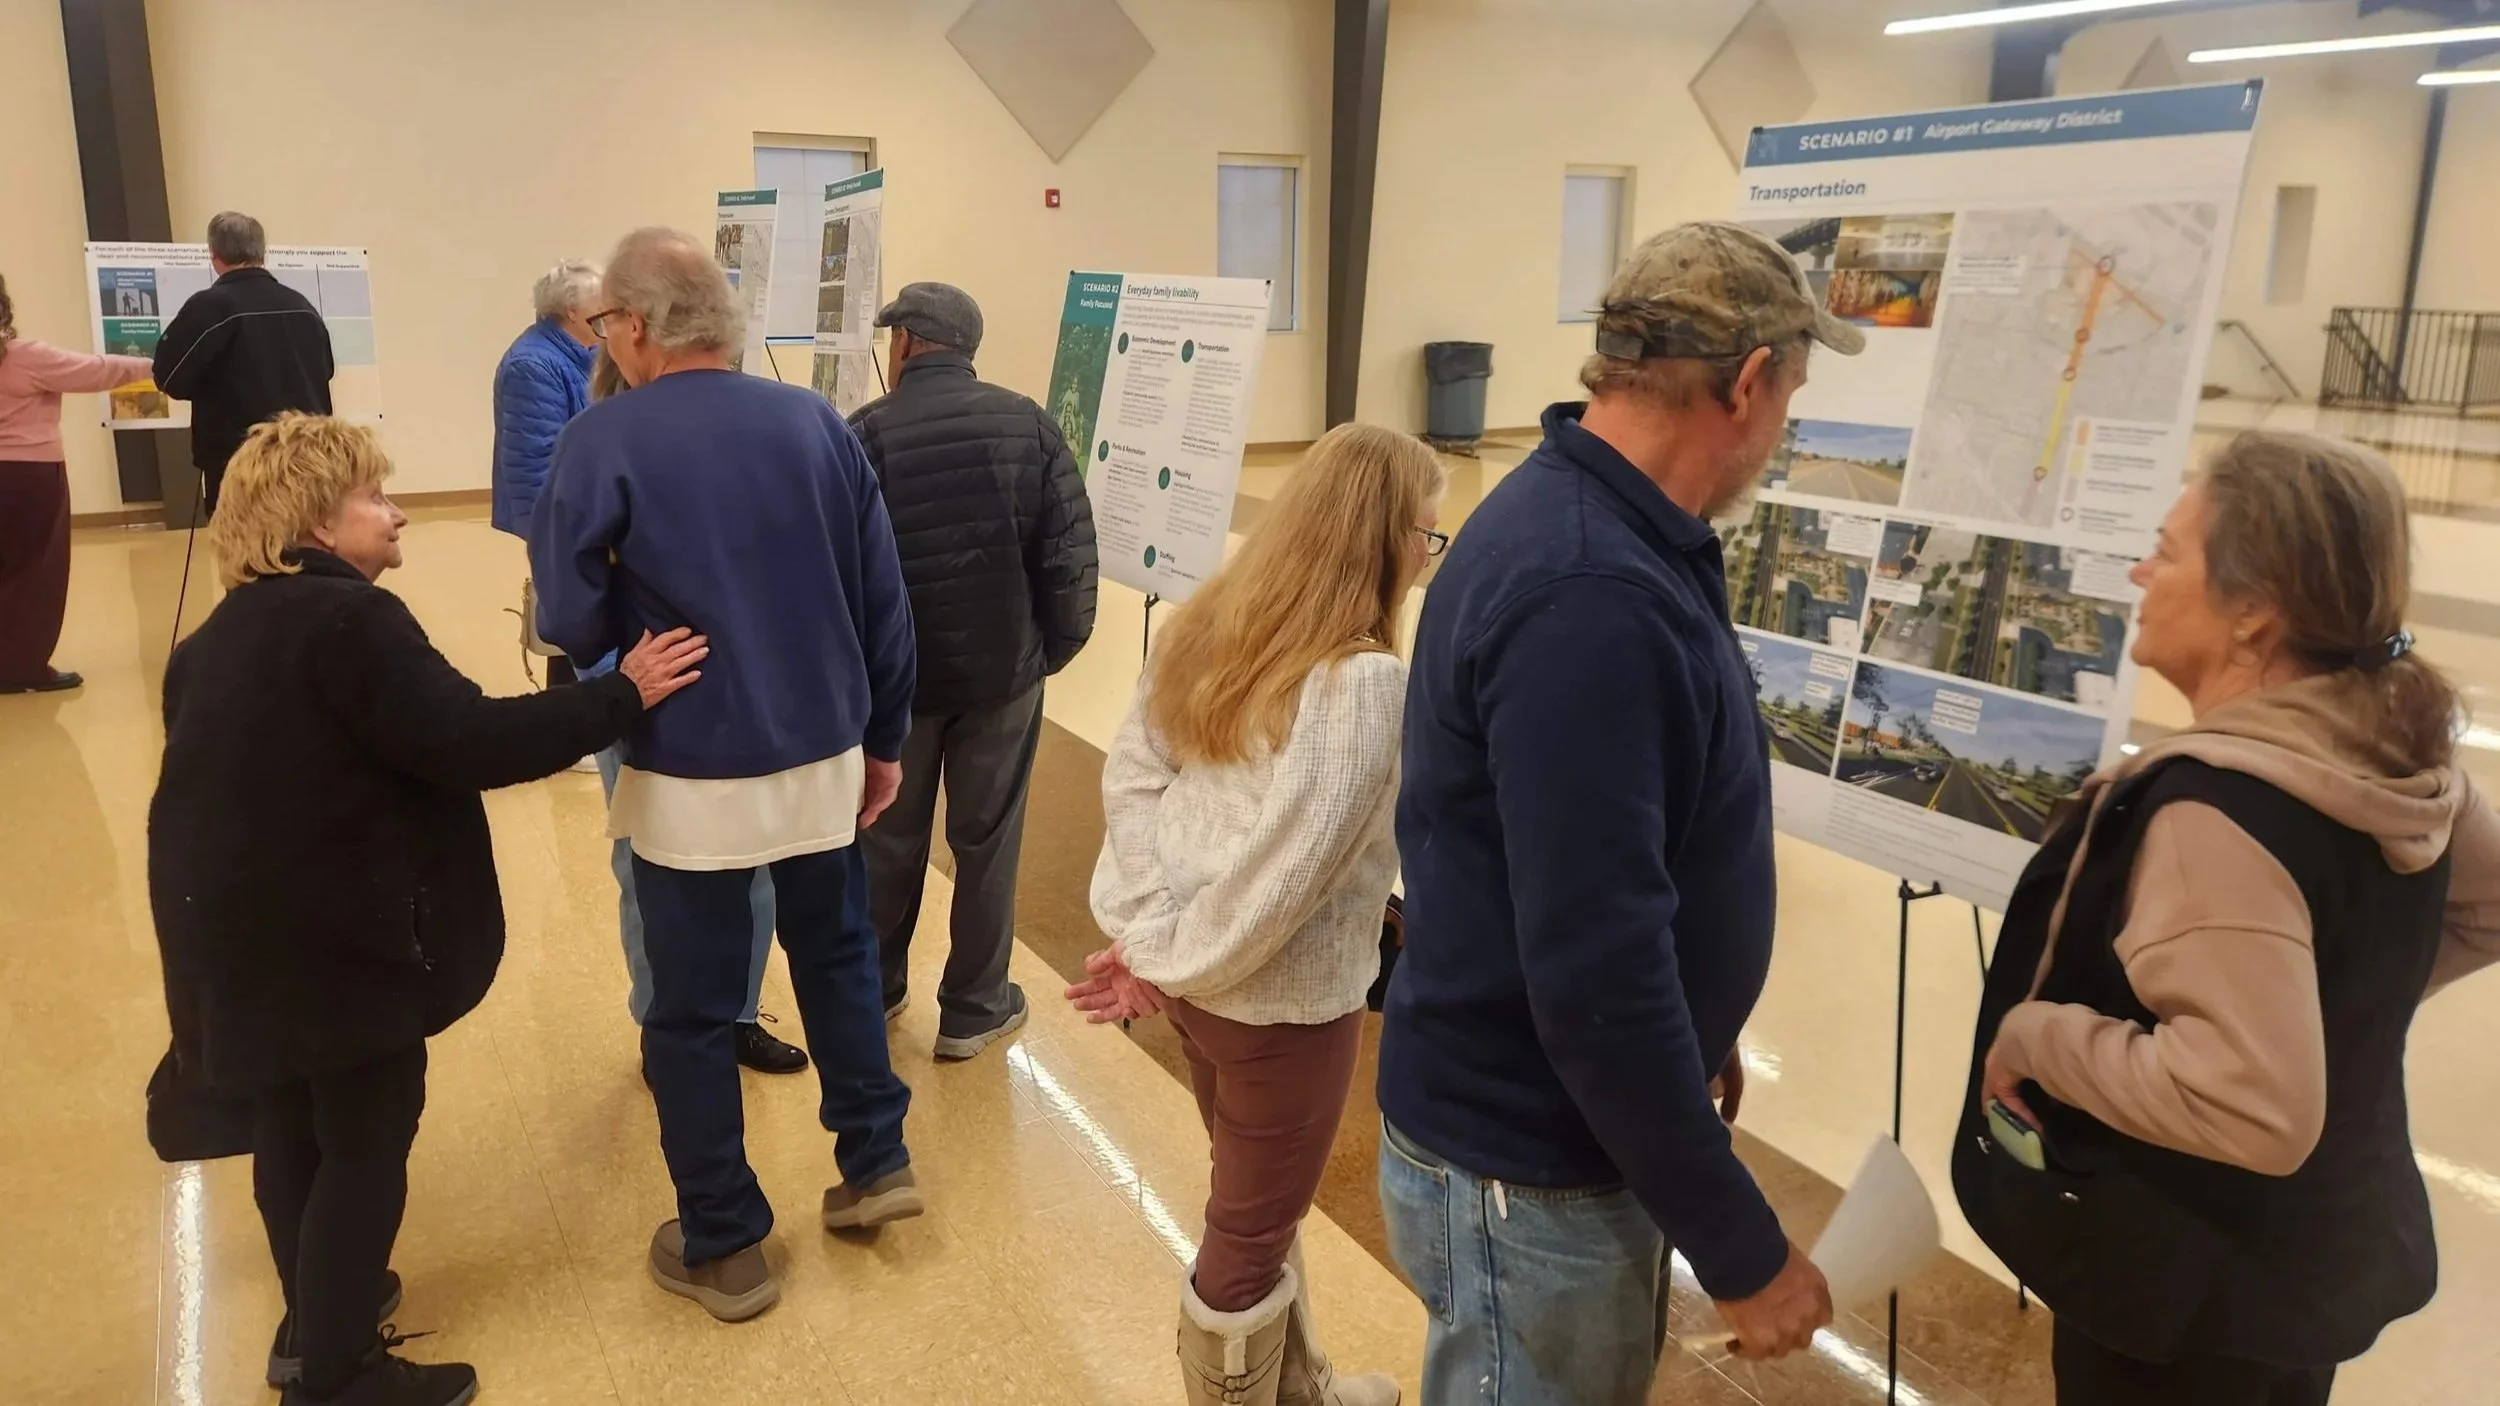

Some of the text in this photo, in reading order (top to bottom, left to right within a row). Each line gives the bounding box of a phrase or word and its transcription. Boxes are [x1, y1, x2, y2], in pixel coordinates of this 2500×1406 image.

[1799, 109, 2123, 150] SCENARIO #1 Airport Gateway District
[1749, 179, 1866, 202] Transportation
[1083, 283, 1119, 294] SCENARIO #2
[1127, 284, 1199, 300] Everyday family livability
[1080, 298, 1113, 309] Family Focused
[1150, 337, 1176, 346] Development
[1198, 342, 1229, 353] Transportation
[1112, 442, 1122, 451] Parks
[1126, 446, 1146, 456] Recreation
[1174, 469, 1191, 480] Housing
